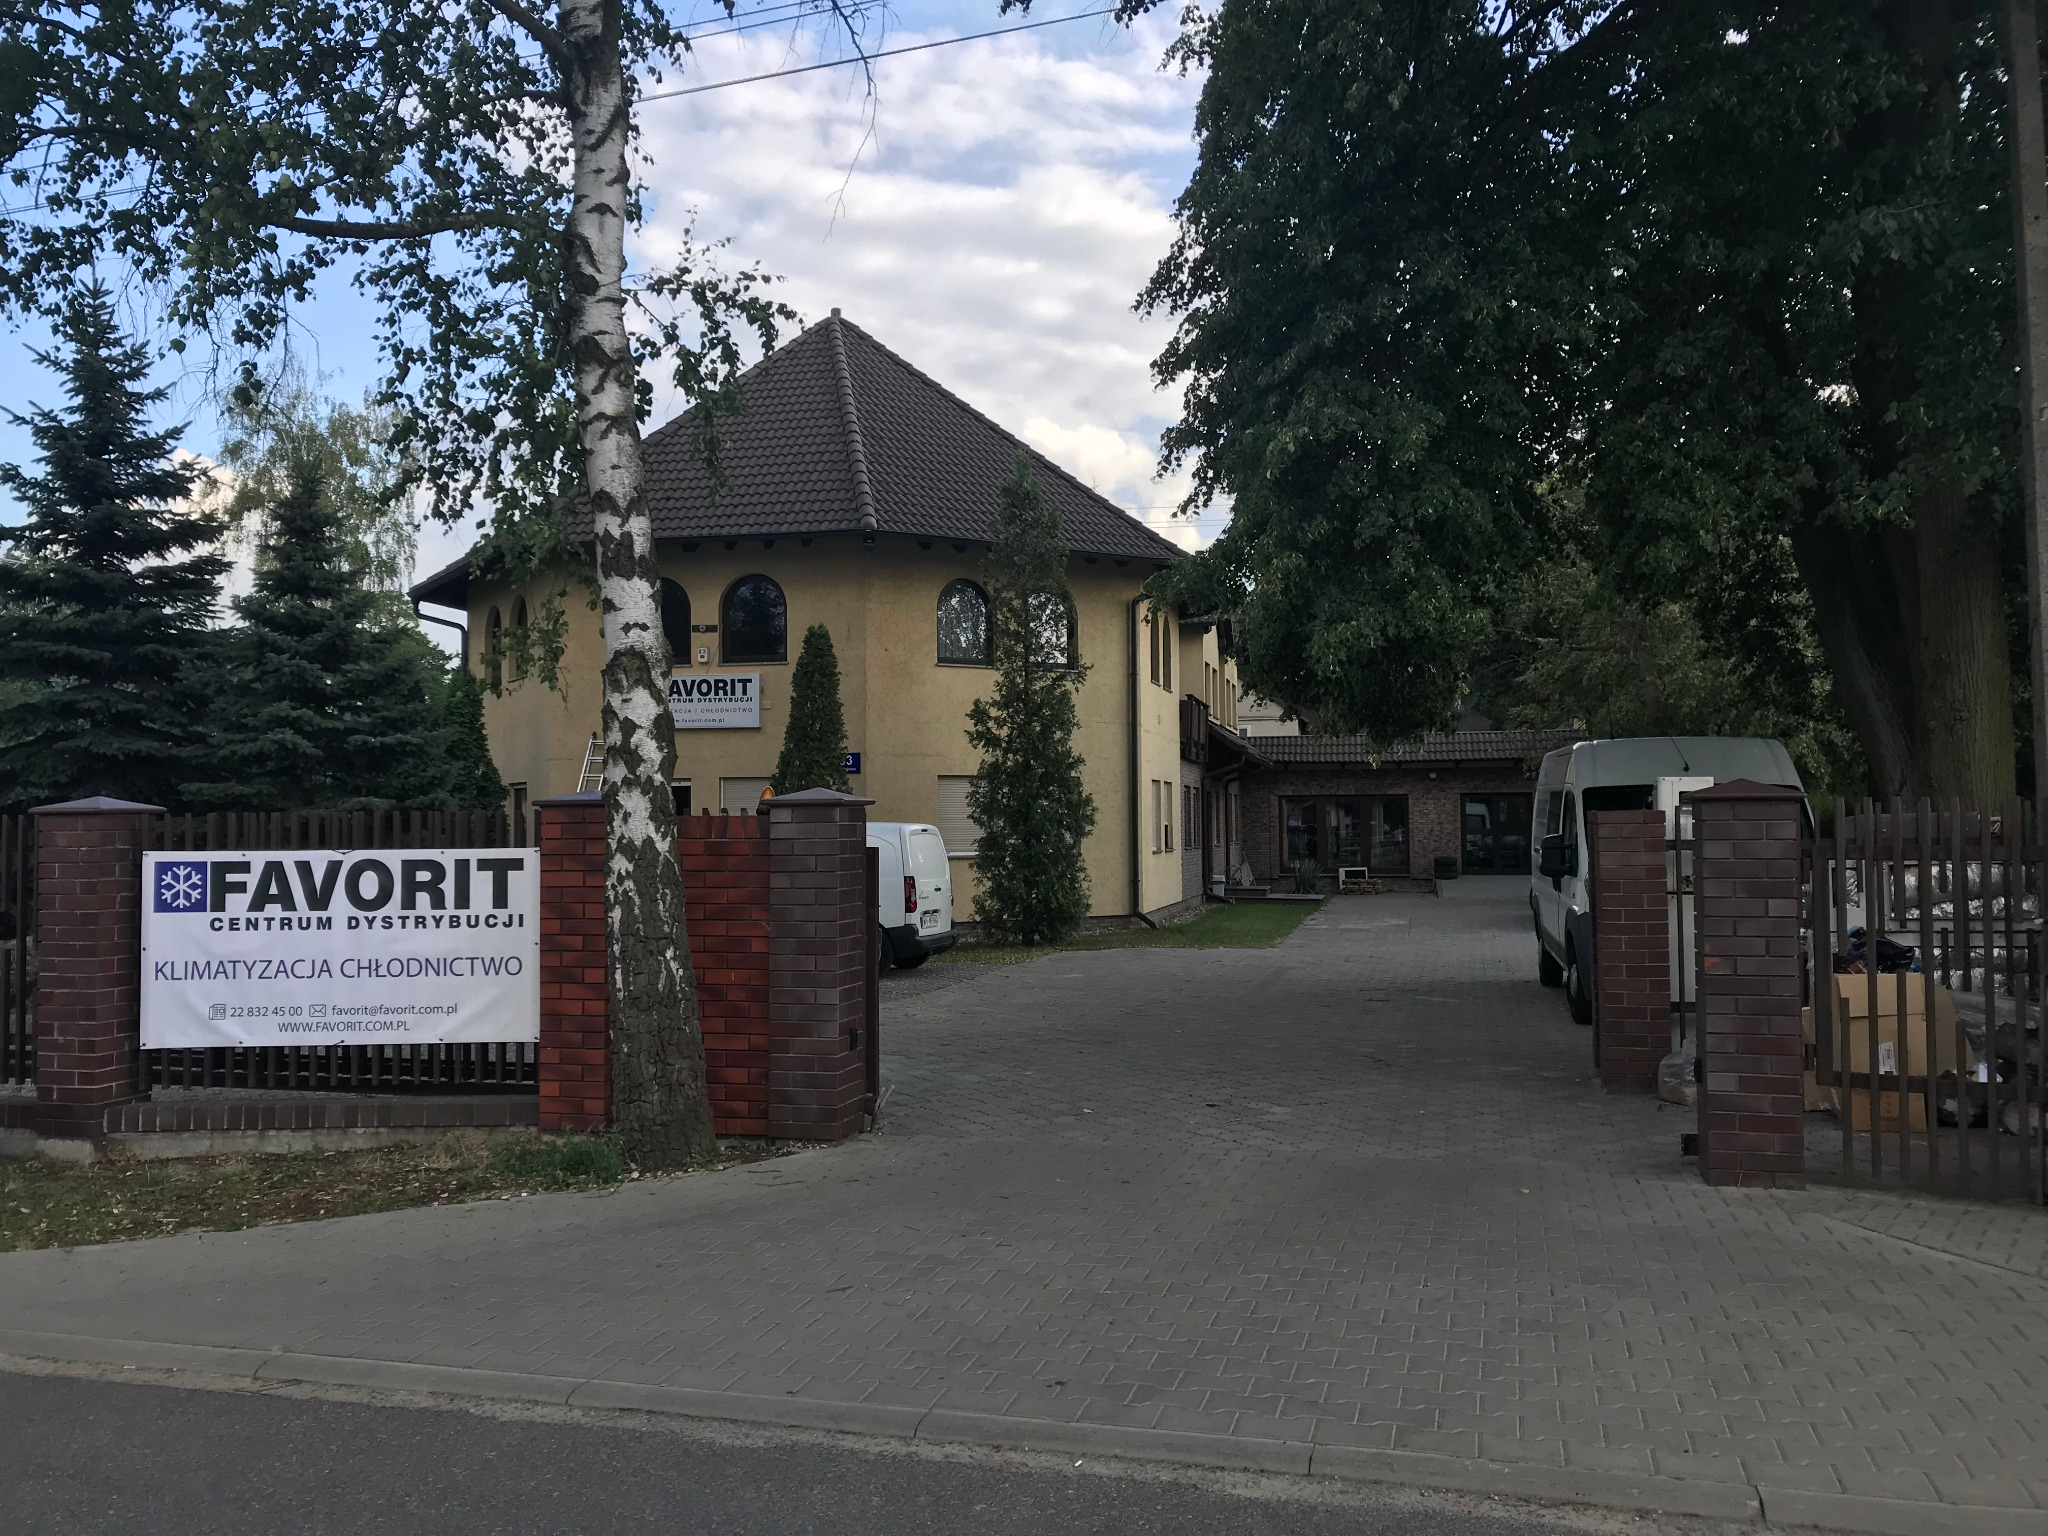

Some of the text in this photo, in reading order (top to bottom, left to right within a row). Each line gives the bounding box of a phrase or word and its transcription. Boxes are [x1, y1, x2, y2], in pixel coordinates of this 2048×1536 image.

[668, 679, 753, 697] AVORIT
[209, 858, 525, 913] FAVORIT
[209, 913, 525, 932] CENTRUM DYSTRYBUCJI
[154, 956, 523, 981] KLIMATYZACJA CHŁODNICTWO
[230, 1003, 458, 1017] 22 832 45 00 favorit@favorit.com.pl
[277, 1020, 411, 1033] WWW.FAVORIT.COM.PL
